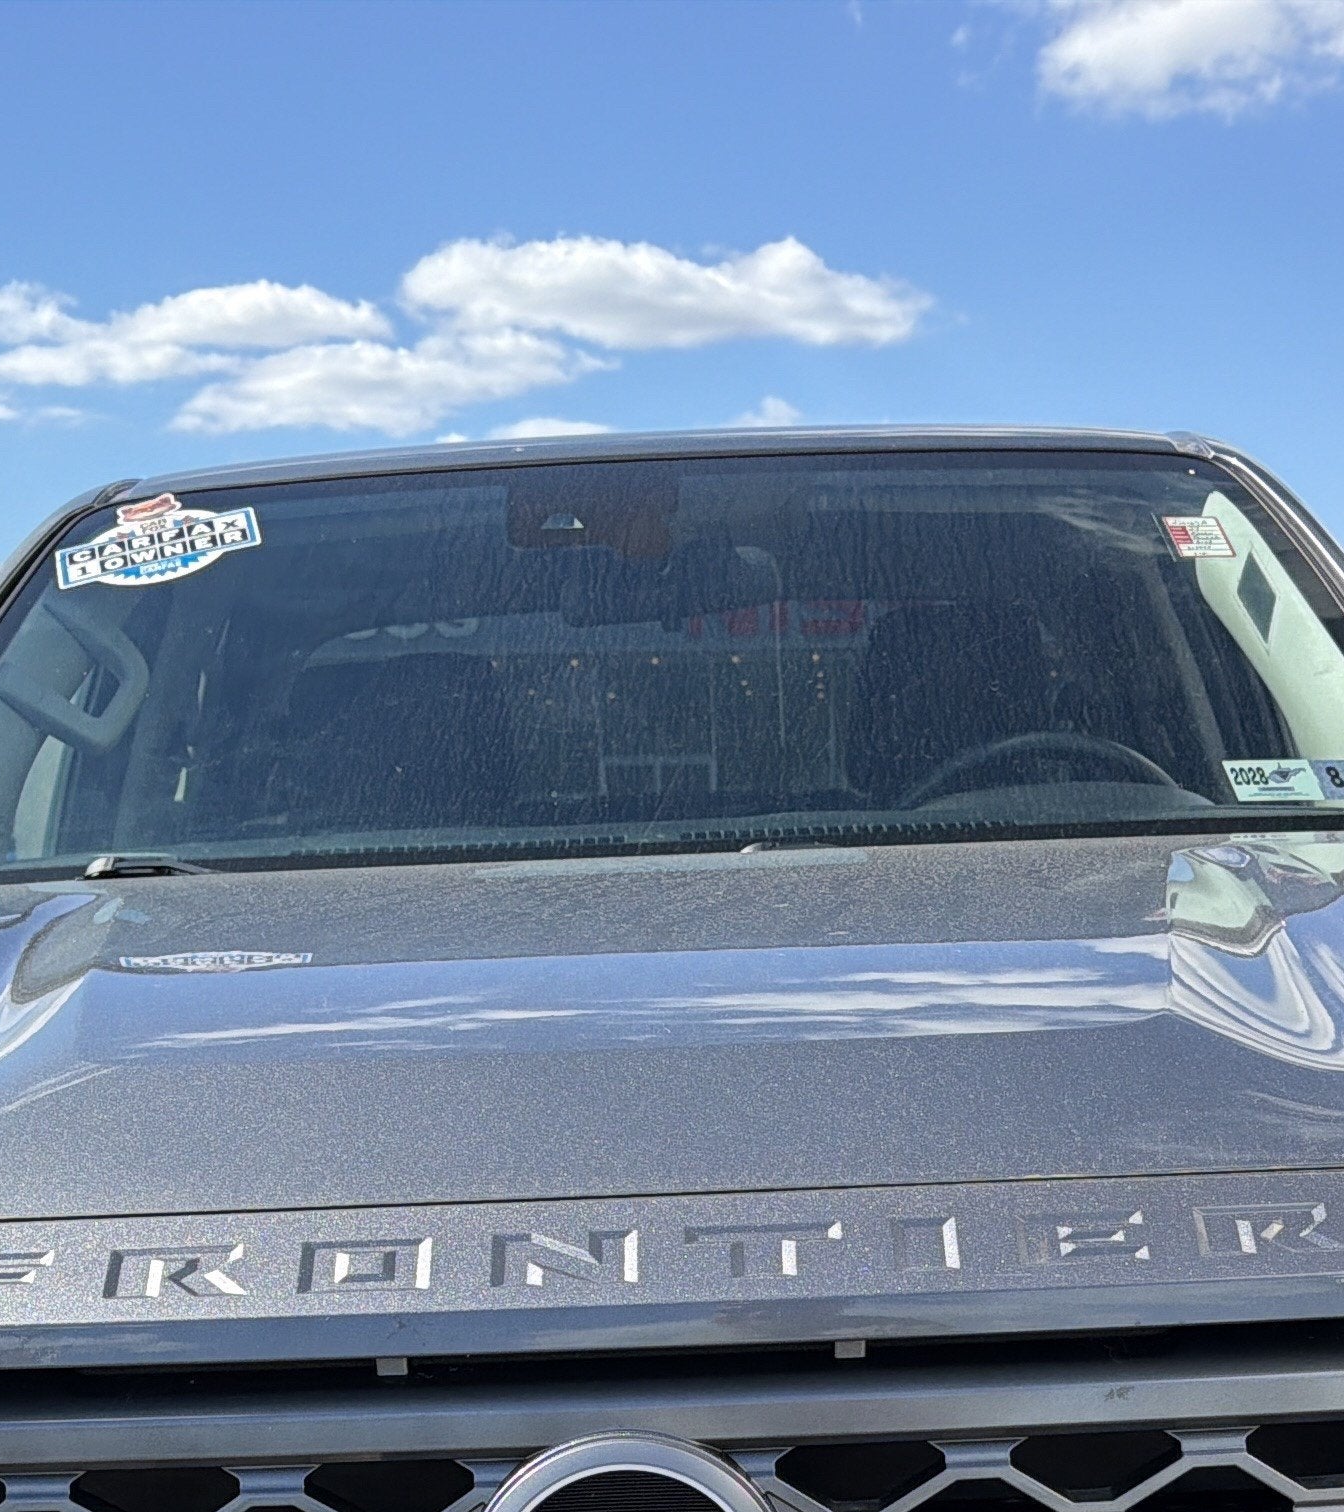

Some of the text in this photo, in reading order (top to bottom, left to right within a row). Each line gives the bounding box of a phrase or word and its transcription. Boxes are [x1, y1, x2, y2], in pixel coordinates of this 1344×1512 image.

[70, 518, 241, 564] CARFAX
[103, 530, 244, 571] OWNER
[1229, 766, 1269, 786] 2028
